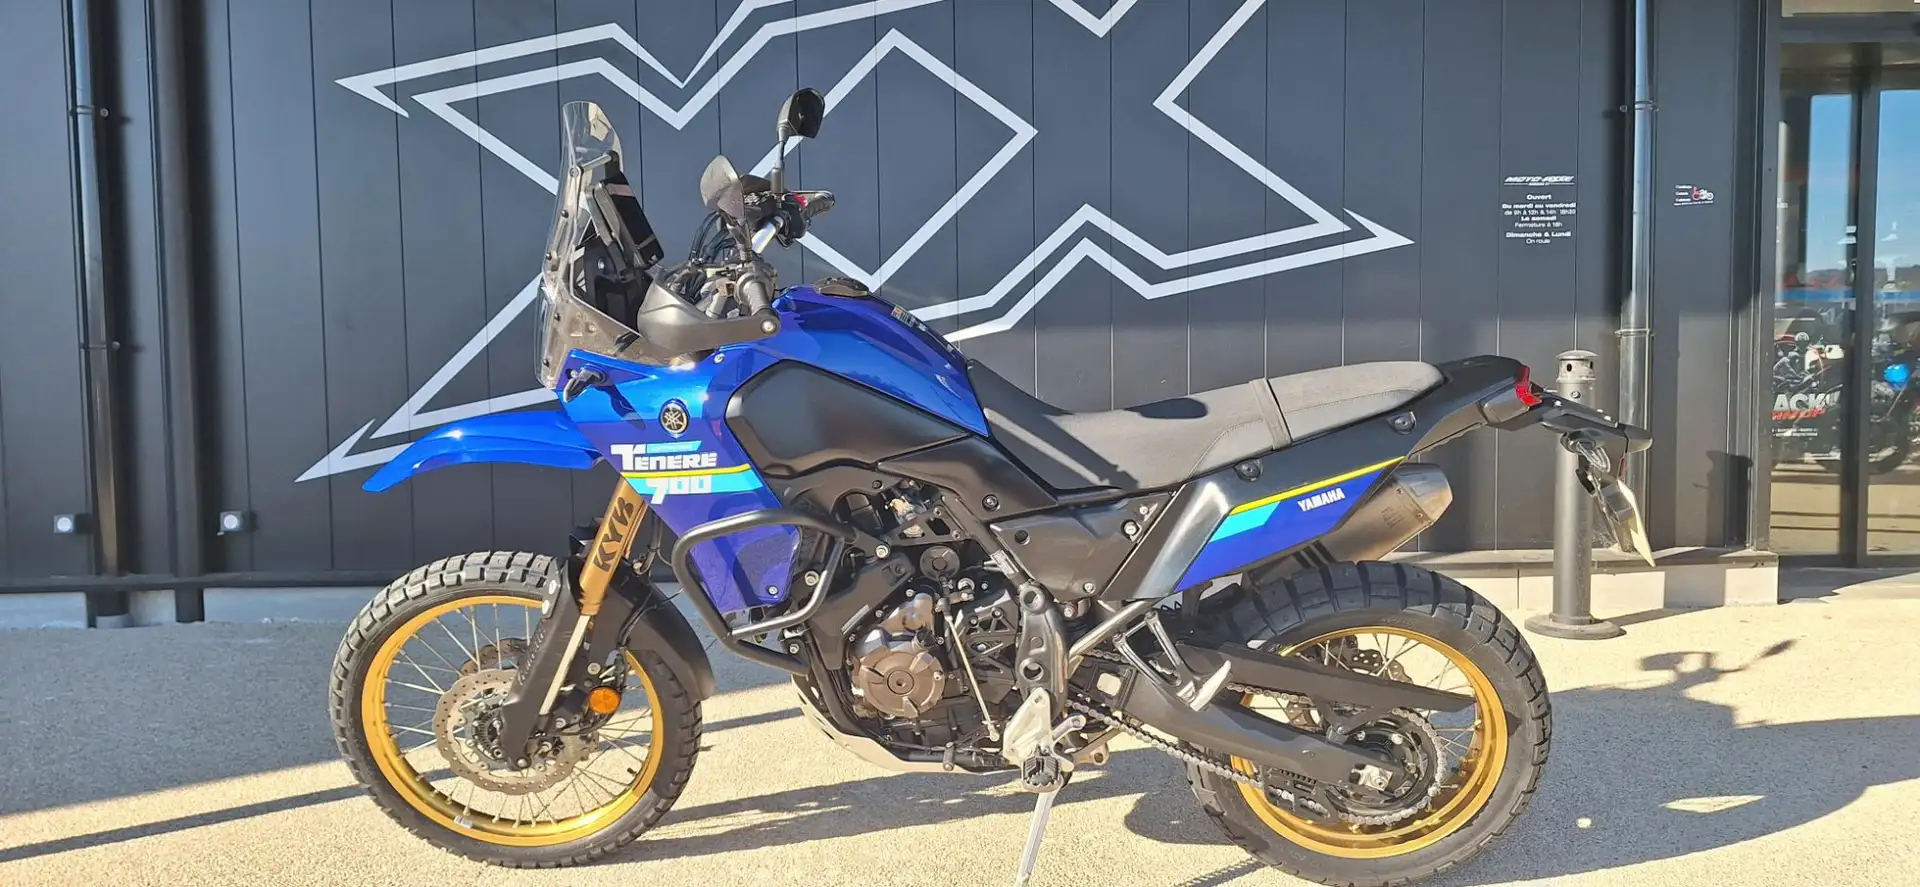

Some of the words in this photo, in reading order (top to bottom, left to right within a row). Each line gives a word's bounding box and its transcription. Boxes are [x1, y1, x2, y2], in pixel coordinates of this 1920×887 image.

[645, 475, 712, 505] 700
[1297, 487, 1346, 512] YAMAHA
[593, 496, 635, 573] KYB
